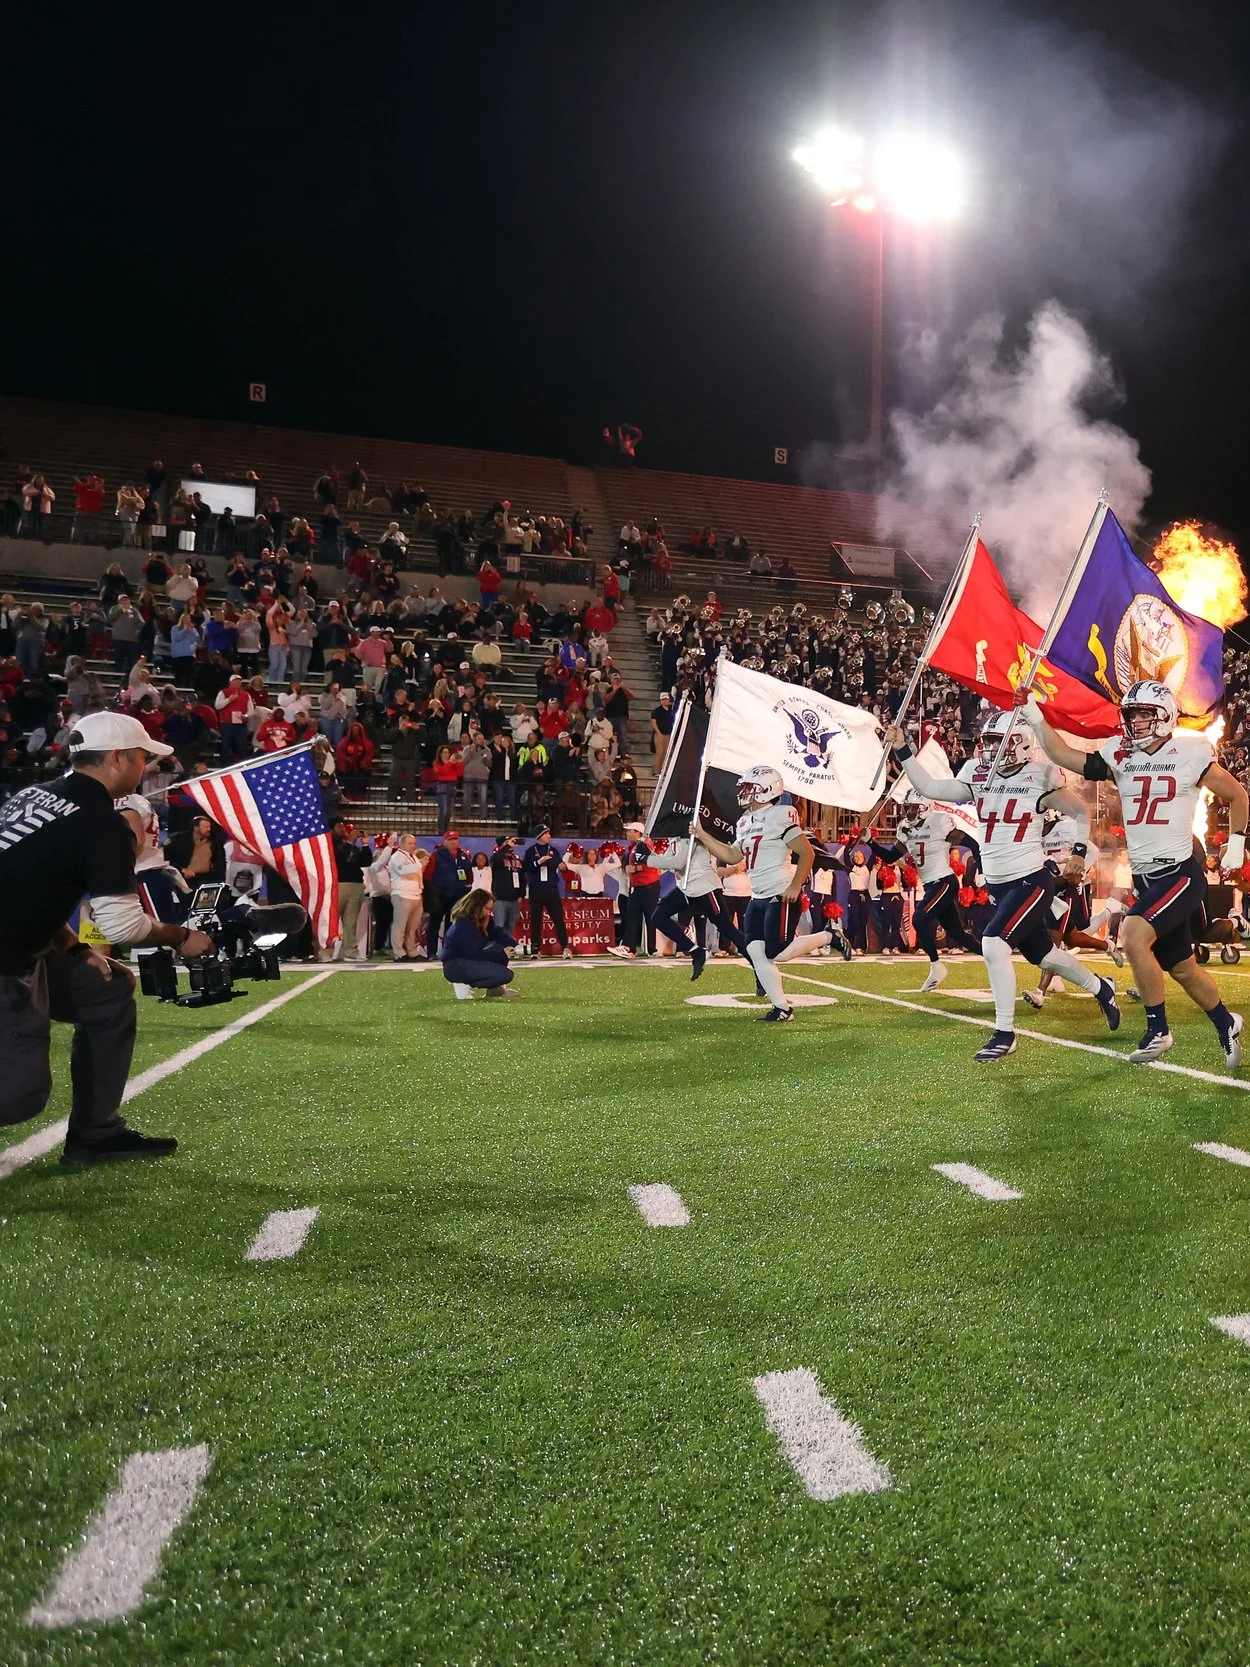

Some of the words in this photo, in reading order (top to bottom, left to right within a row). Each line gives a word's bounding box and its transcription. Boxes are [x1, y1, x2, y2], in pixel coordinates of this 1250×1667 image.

[253, 385, 263, 400] R
[777, 450, 785, 461] S
[782, 759, 806, 775] SEMPER
[808, 772, 836, 781] PARATUS
[1126, 775, 1177, 826] 32
[977, 797, 1034, 844] 44
[740, 836, 764, 871] 47
[915, 841, 926, 867] 3
[564, 909, 610, 920] USEUM
[523, 922, 601, 933] UIVRSITY
